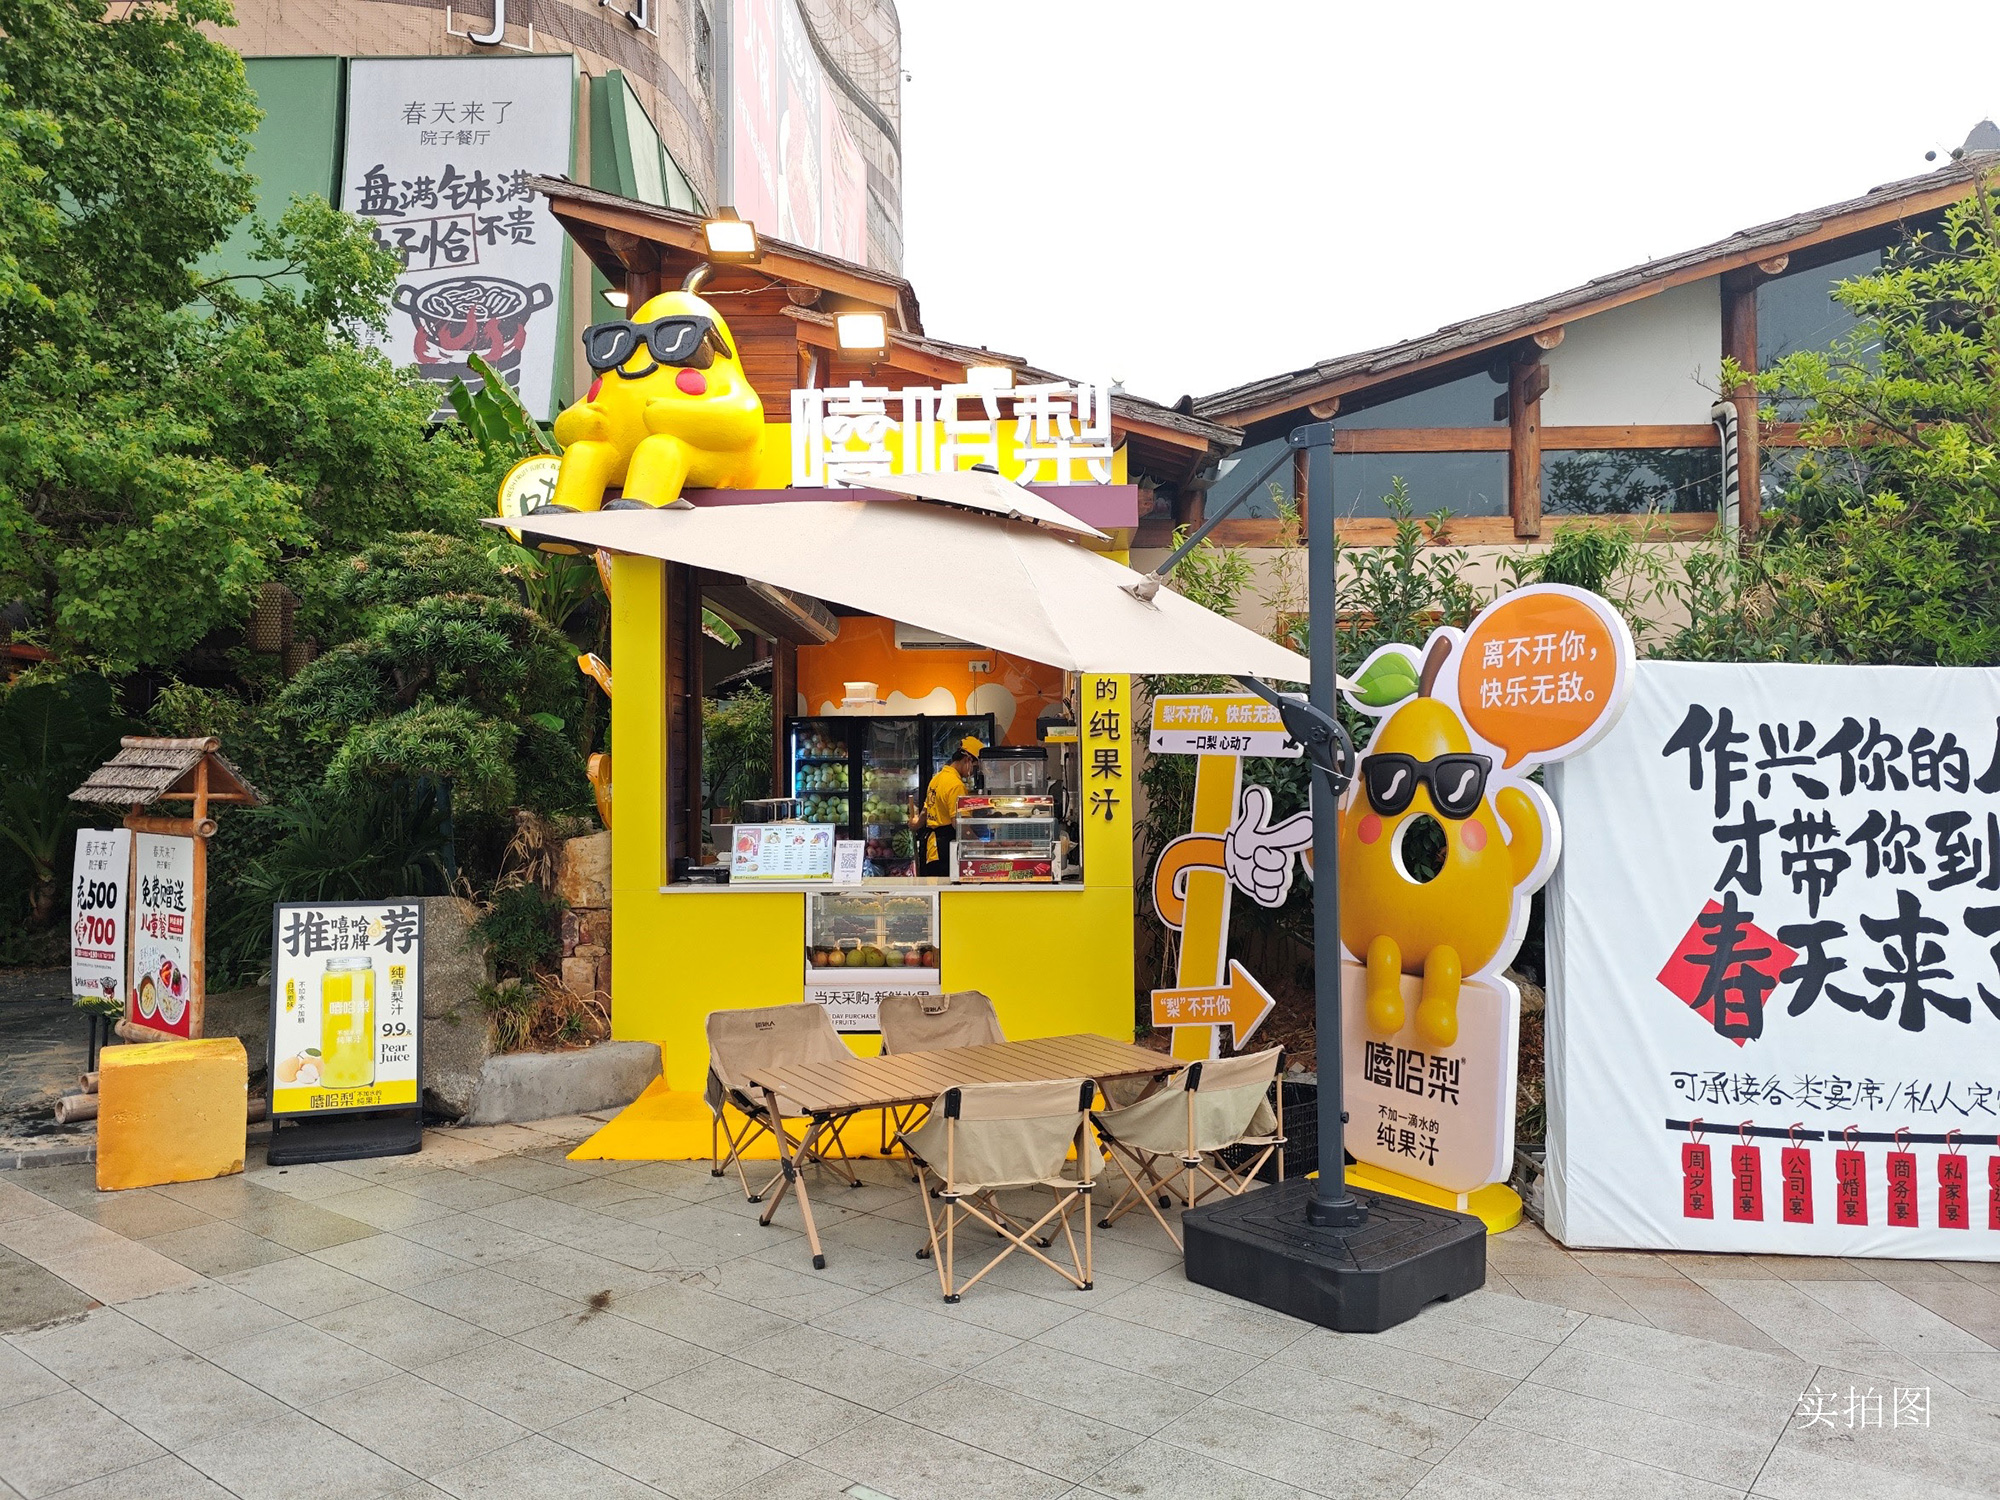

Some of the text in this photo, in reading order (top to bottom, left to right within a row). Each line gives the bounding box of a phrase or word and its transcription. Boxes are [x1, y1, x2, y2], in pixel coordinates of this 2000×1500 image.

[401, 100, 513, 125] 春天来了
[420, 129, 491, 146] 院子餐厅
[355, 163, 537, 217] 盘满钵满
[790, 380, 1114, 488] 嘻哈梨
[1481, 629, 1598, 669] 离不开你，
[1479, 671, 1595, 709] 快乐无敌。
[1089, 678, 1122, 821] 的纯果汁
[1186, 735, 1252, 751] 一口梨 心动了
[86, 841, 116, 856] 春天来了
[142, 874, 187, 912] 免费赠送
[140, 907, 168, 940] 儿童餐
[282, 911, 332, 957] 推
[373, 906, 419, 954] 荐
[390, 966, 404, 1016] 纯雪梨汁
[379, 1051, 410, 1064] Juice
[381, 1043, 408, 1053] Pear
[1670, 1071, 2000, 1116] 可承接各类宴席/私人定
[1378, 1104, 1440, 1134] 不加一滴水的
[1377, 1122, 1440, 1167] 纯果汁
[1687, 1150, 1706, 1211] 周岁宴
[1738, 1152, 1755, 1214] 生日宴
[1788, 1155, 1805, 1216] 公司宴
[1841, 1157, 1859, 1218] 订婚宴
[1893, 1159, 1911, 1220] 商务宴
[1944, 1161, 1962, 1222] 私家宴
